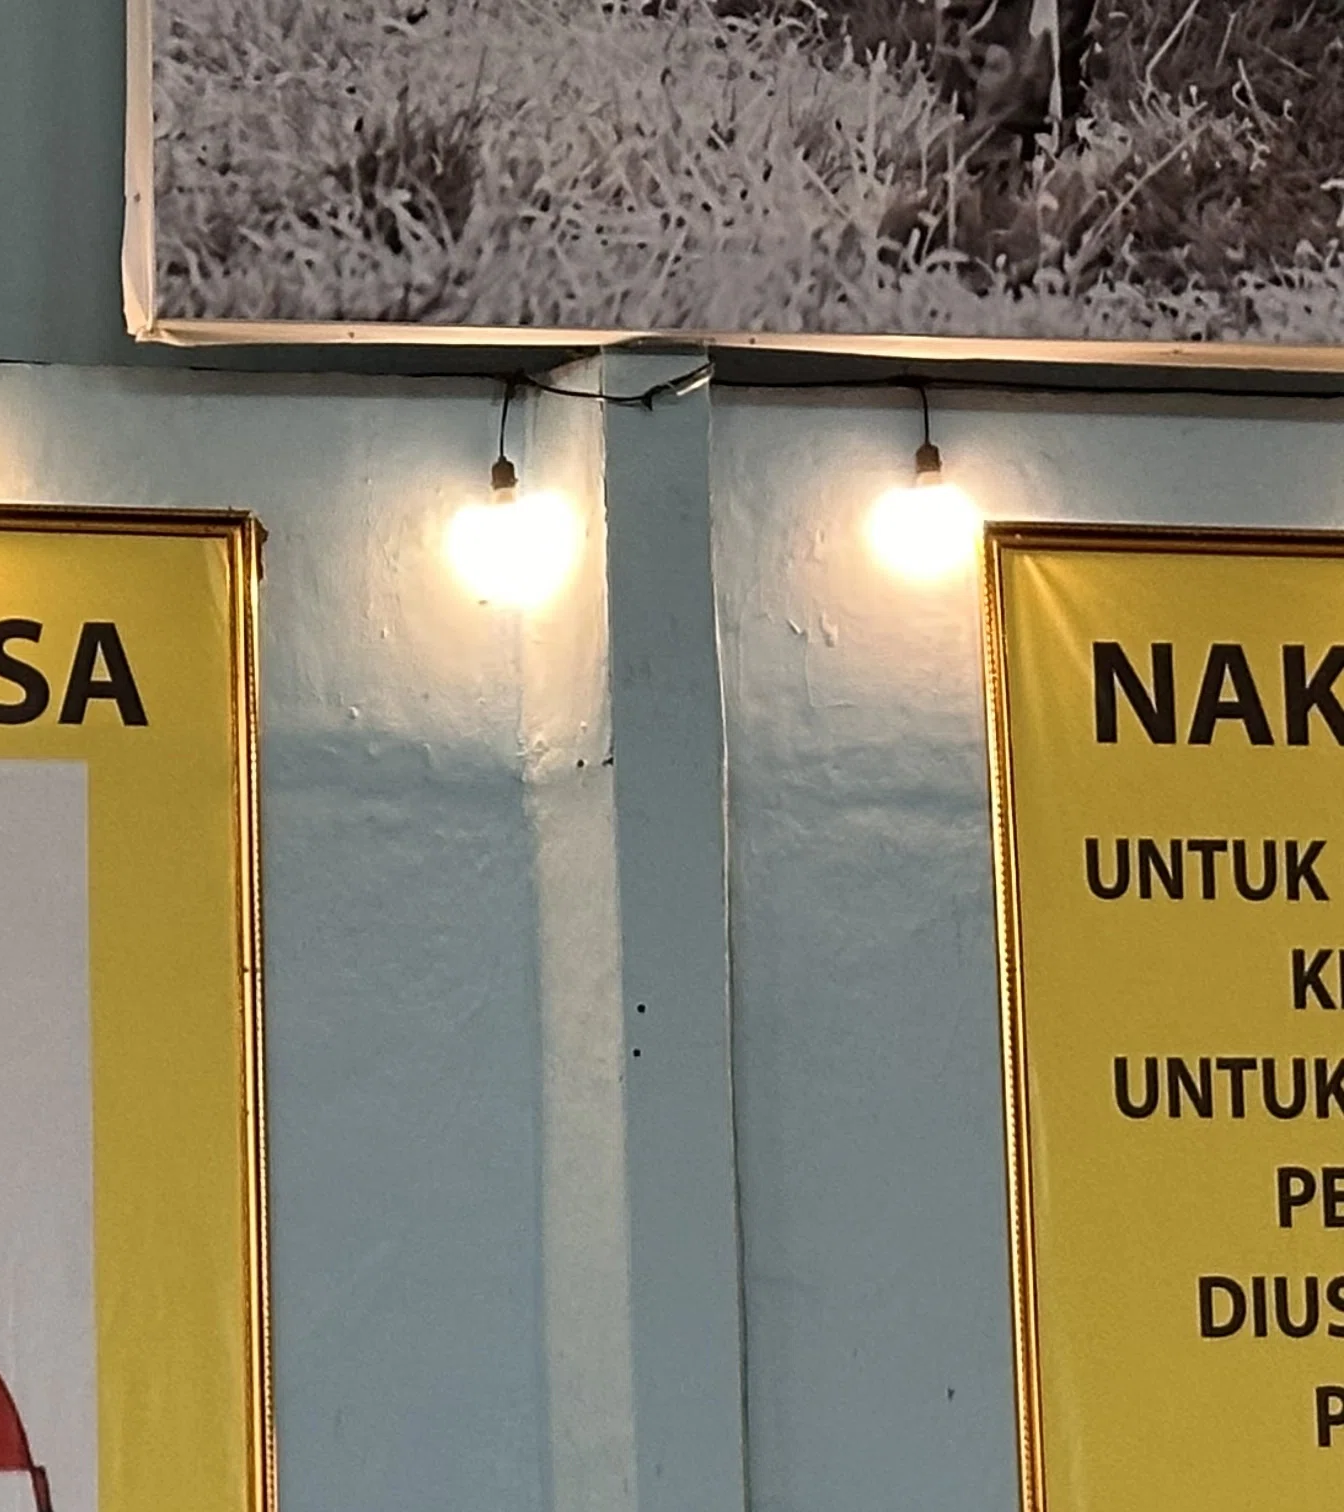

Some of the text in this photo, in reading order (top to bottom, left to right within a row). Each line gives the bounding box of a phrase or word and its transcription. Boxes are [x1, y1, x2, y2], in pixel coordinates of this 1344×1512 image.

[1093, 642, 1344, 746] NAK
[1086, 839, 1329, 901] UNTUK
[1292, 949, 1344, 1010] K
[1115, 1057, 1344, 1120] UNTUK
